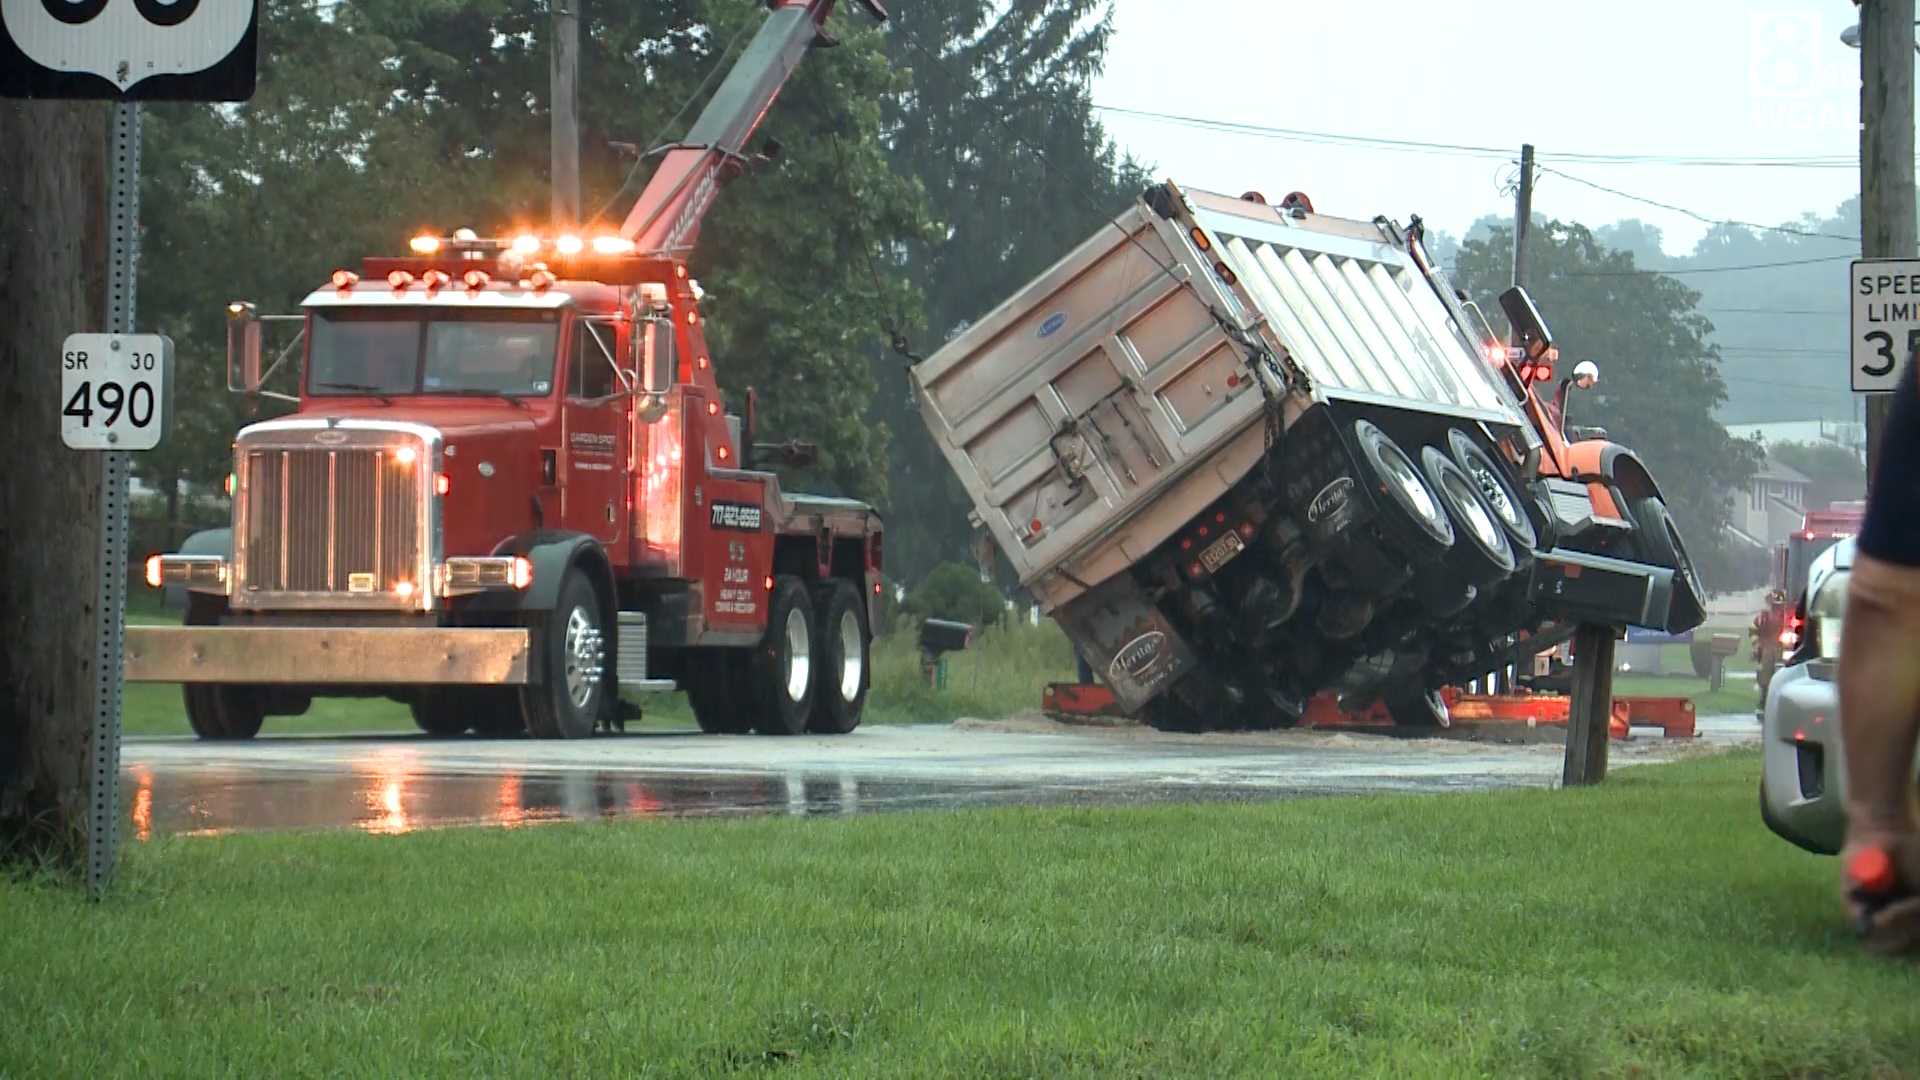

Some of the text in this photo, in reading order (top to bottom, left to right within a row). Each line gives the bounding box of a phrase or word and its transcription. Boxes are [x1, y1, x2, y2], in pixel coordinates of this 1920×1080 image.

[64, 351, 154, 370] SR 30
[63, 381, 154, 428] 490
